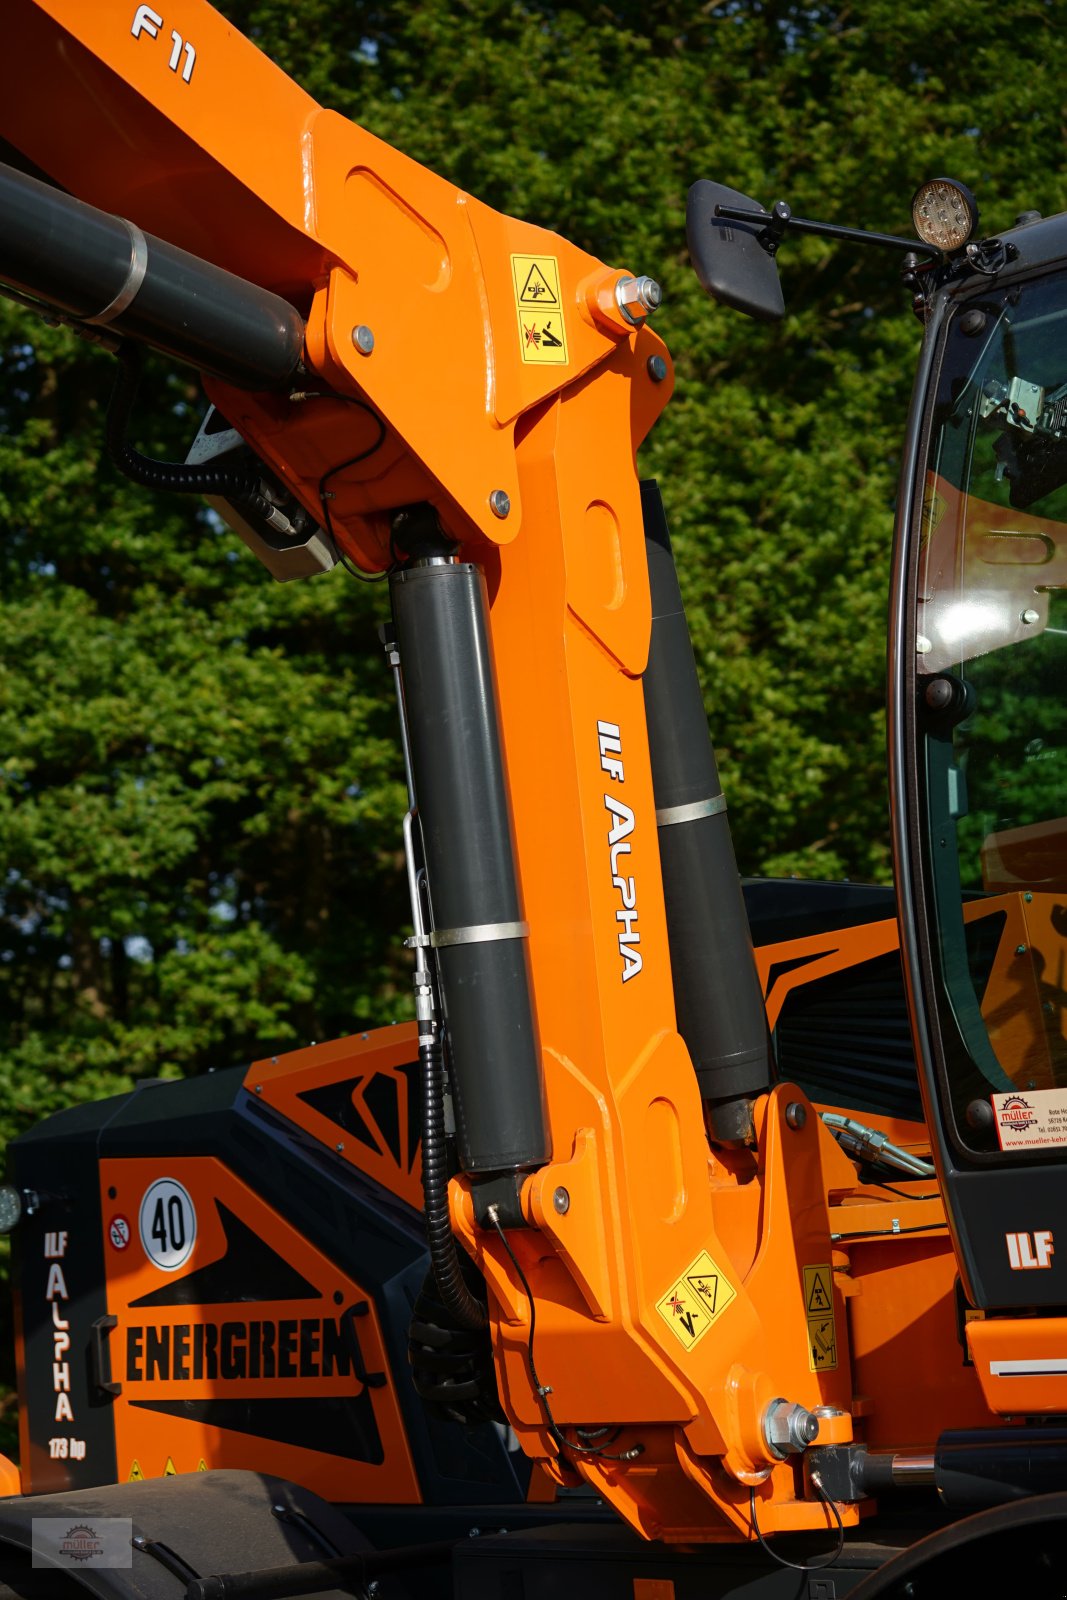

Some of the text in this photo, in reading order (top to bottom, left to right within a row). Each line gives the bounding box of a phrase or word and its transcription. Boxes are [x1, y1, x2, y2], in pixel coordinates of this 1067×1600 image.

[131, 4, 196, 85] F 11
[597, 720, 643, 984] ILF ALPHA
[1002, 1110, 1033, 1121] müller
[45, 1231, 68, 1259] ILF
[152, 1195, 186, 1252] 40
[1005, 1231, 1055, 1270] ILF
[46, 1263, 74, 1421] ALPHA
[126, 1317, 352, 1382] ENERGREEN
[49, 1438, 86, 1460] 173 hp
